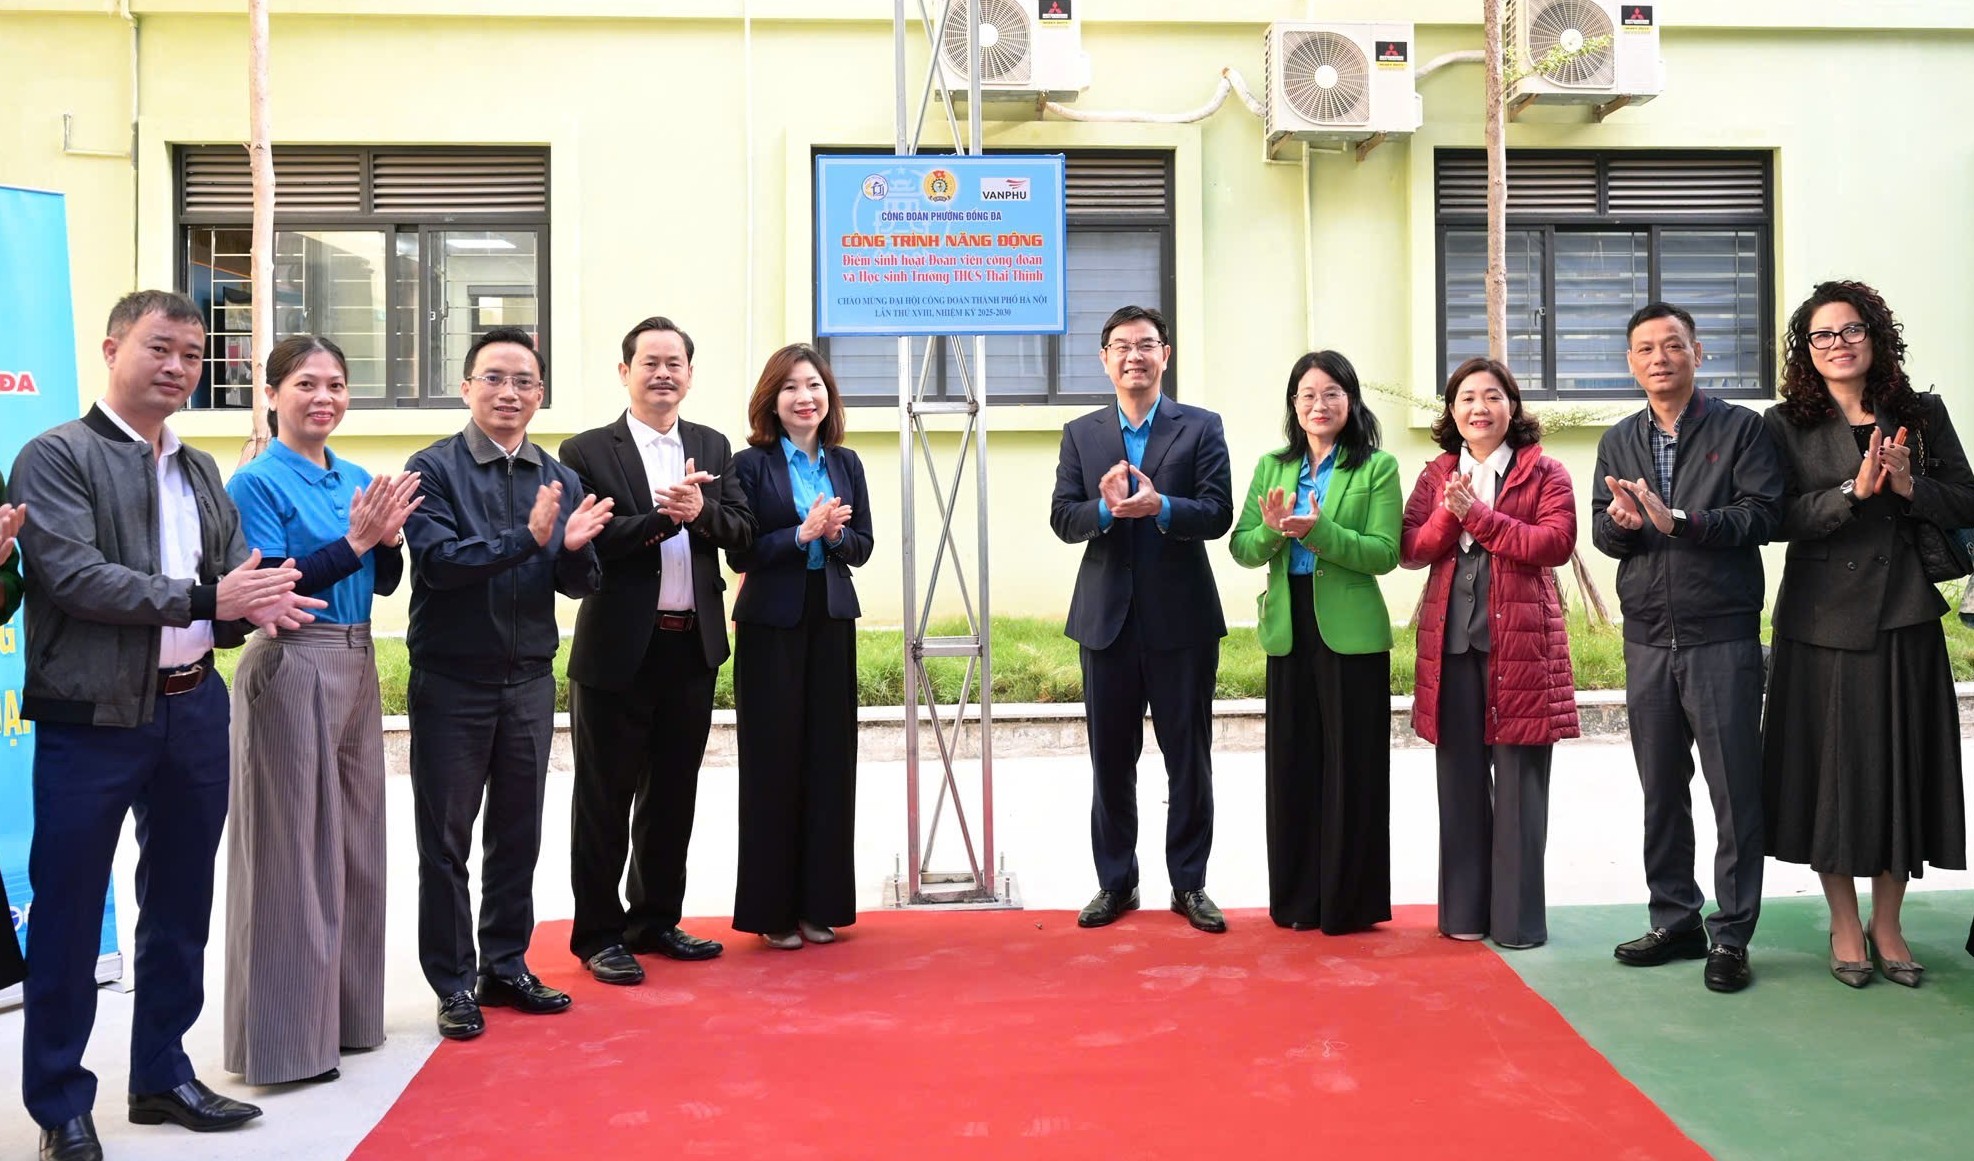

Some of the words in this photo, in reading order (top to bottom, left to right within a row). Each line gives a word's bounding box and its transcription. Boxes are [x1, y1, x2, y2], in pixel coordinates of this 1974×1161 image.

[982, 191, 1027, 200] VANPHU
[881, 210, 904, 221] CÔNG
[906, 210, 929, 221] ĐOÀN
[931, 210, 964, 221] PHƯỜNG
[990, 211, 1002, 221] ĐA
[841, 233, 886, 248] CÔNG
[890, 233, 940, 248] TRÌNH
[945, 232, 992, 247] NĂNG
[997, 232, 1043, 249] ĐỘNG
[874, 254, 898, 266] sinh
[901, 254, 925, 268] hoạt
[859, 270, 880, 283] Học
[883, 270, 908, 282] sinh
[954, 270, 982, 281] THCS
[905, 296, 920, 306] HỘI
[922, 296, 945, 305] CÔNG
[1032, 294, 1048, 305] NỘI
[977, 308, 1012, 317] 2025-2030
